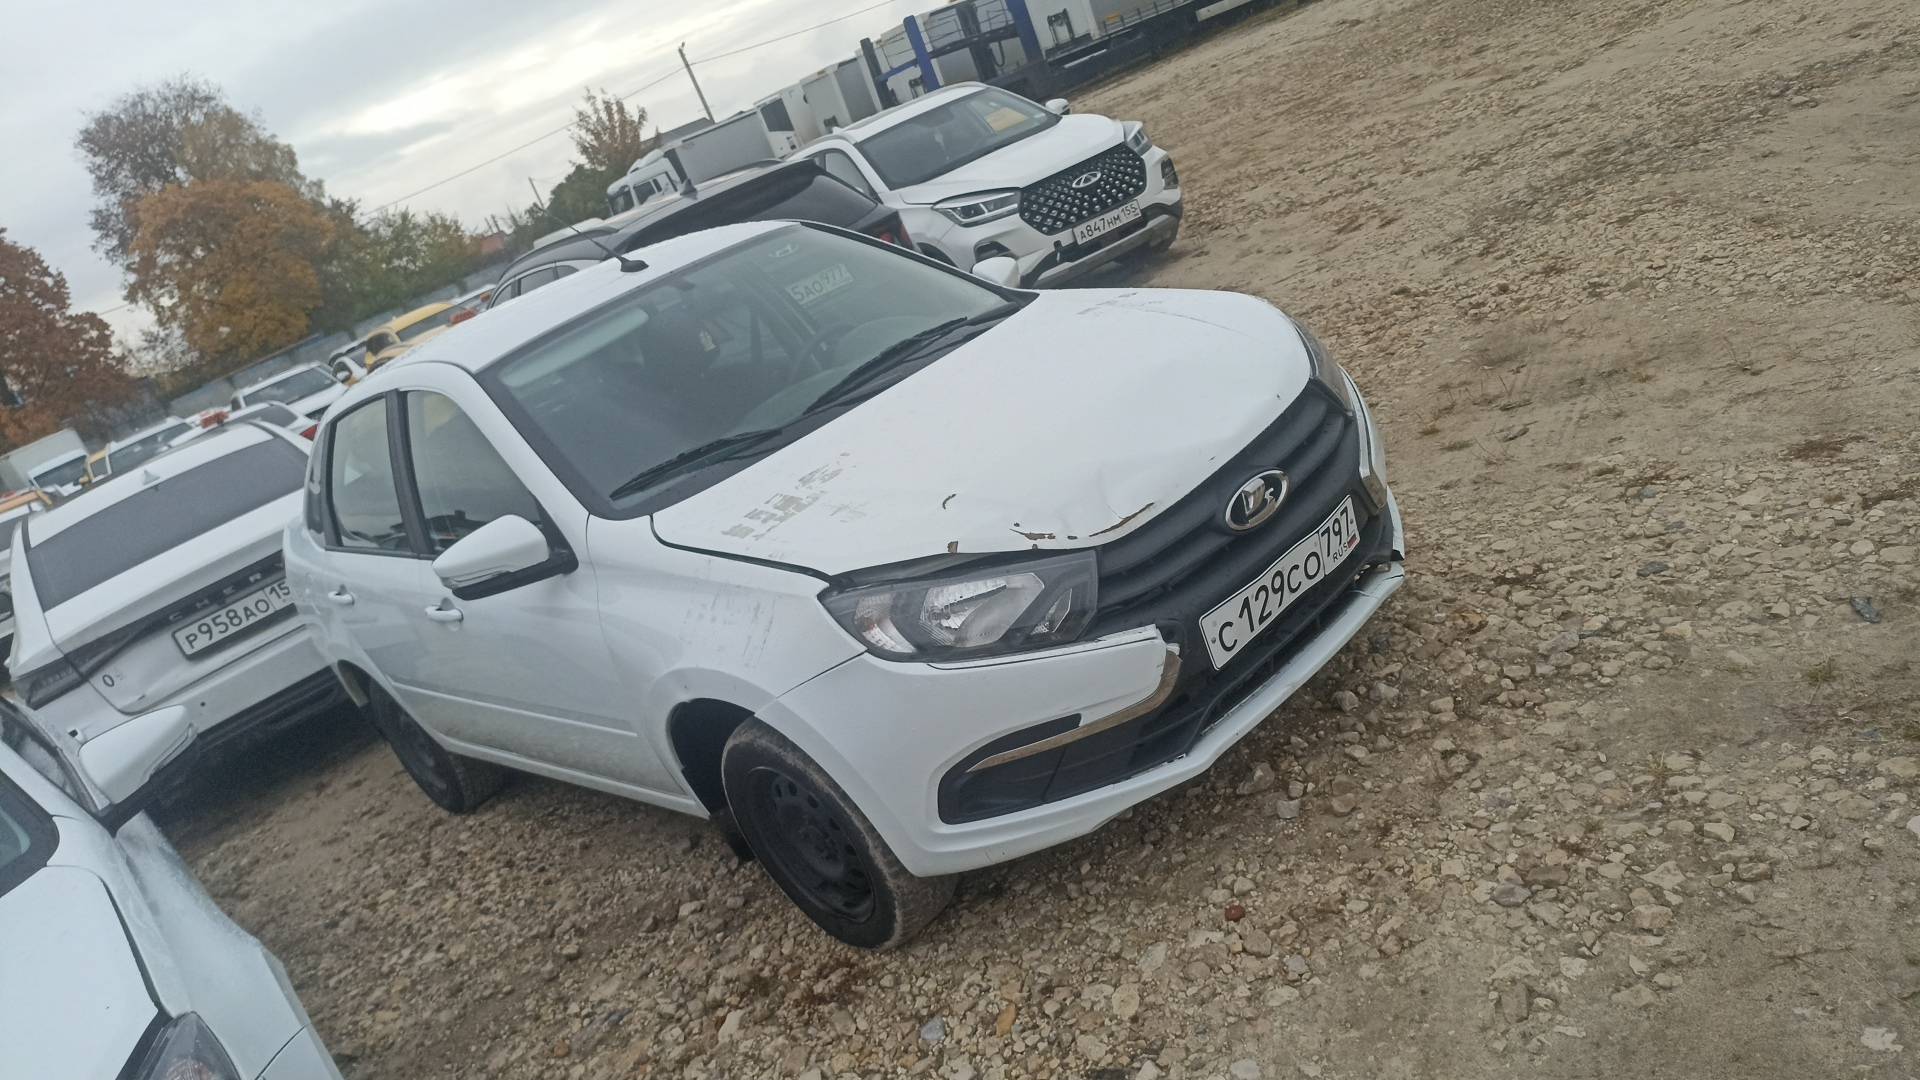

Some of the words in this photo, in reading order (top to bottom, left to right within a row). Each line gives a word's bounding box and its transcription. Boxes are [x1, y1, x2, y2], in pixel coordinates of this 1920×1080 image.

[1080, 215, 1121, 240] A847HM
[1332, 542, 1348, 564] RUS
[1218, 551, 1321, 652] C129CO
[1321, 506, 1350, 557] 797
[185, 598, 270, 650] P958AO
